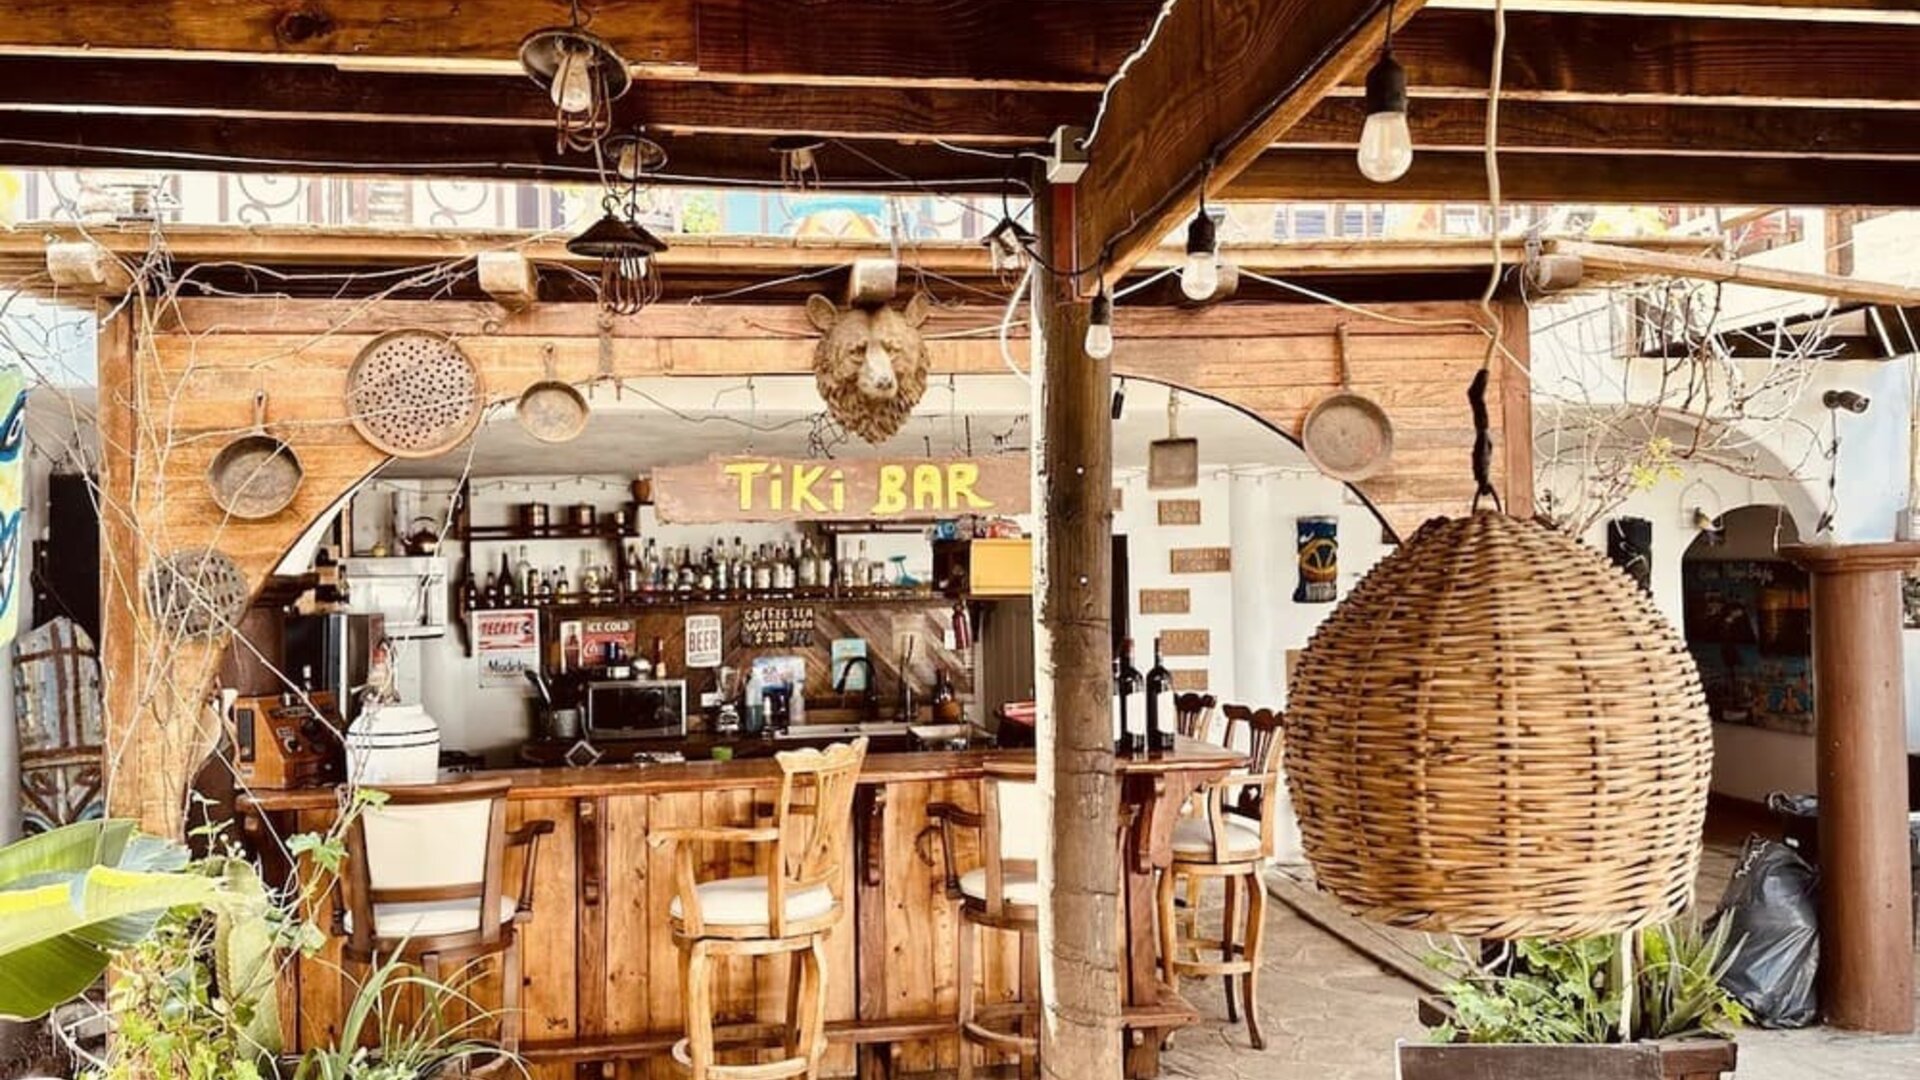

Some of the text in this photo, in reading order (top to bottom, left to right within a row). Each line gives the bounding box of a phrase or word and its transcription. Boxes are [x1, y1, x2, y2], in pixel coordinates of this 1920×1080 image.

[870, 462, 996, 515] BAR
[480, 620, 520, 636] TECATE
[587, 621, 630, 633] ICE COLD
[688, 629, 720, 653] BEER
